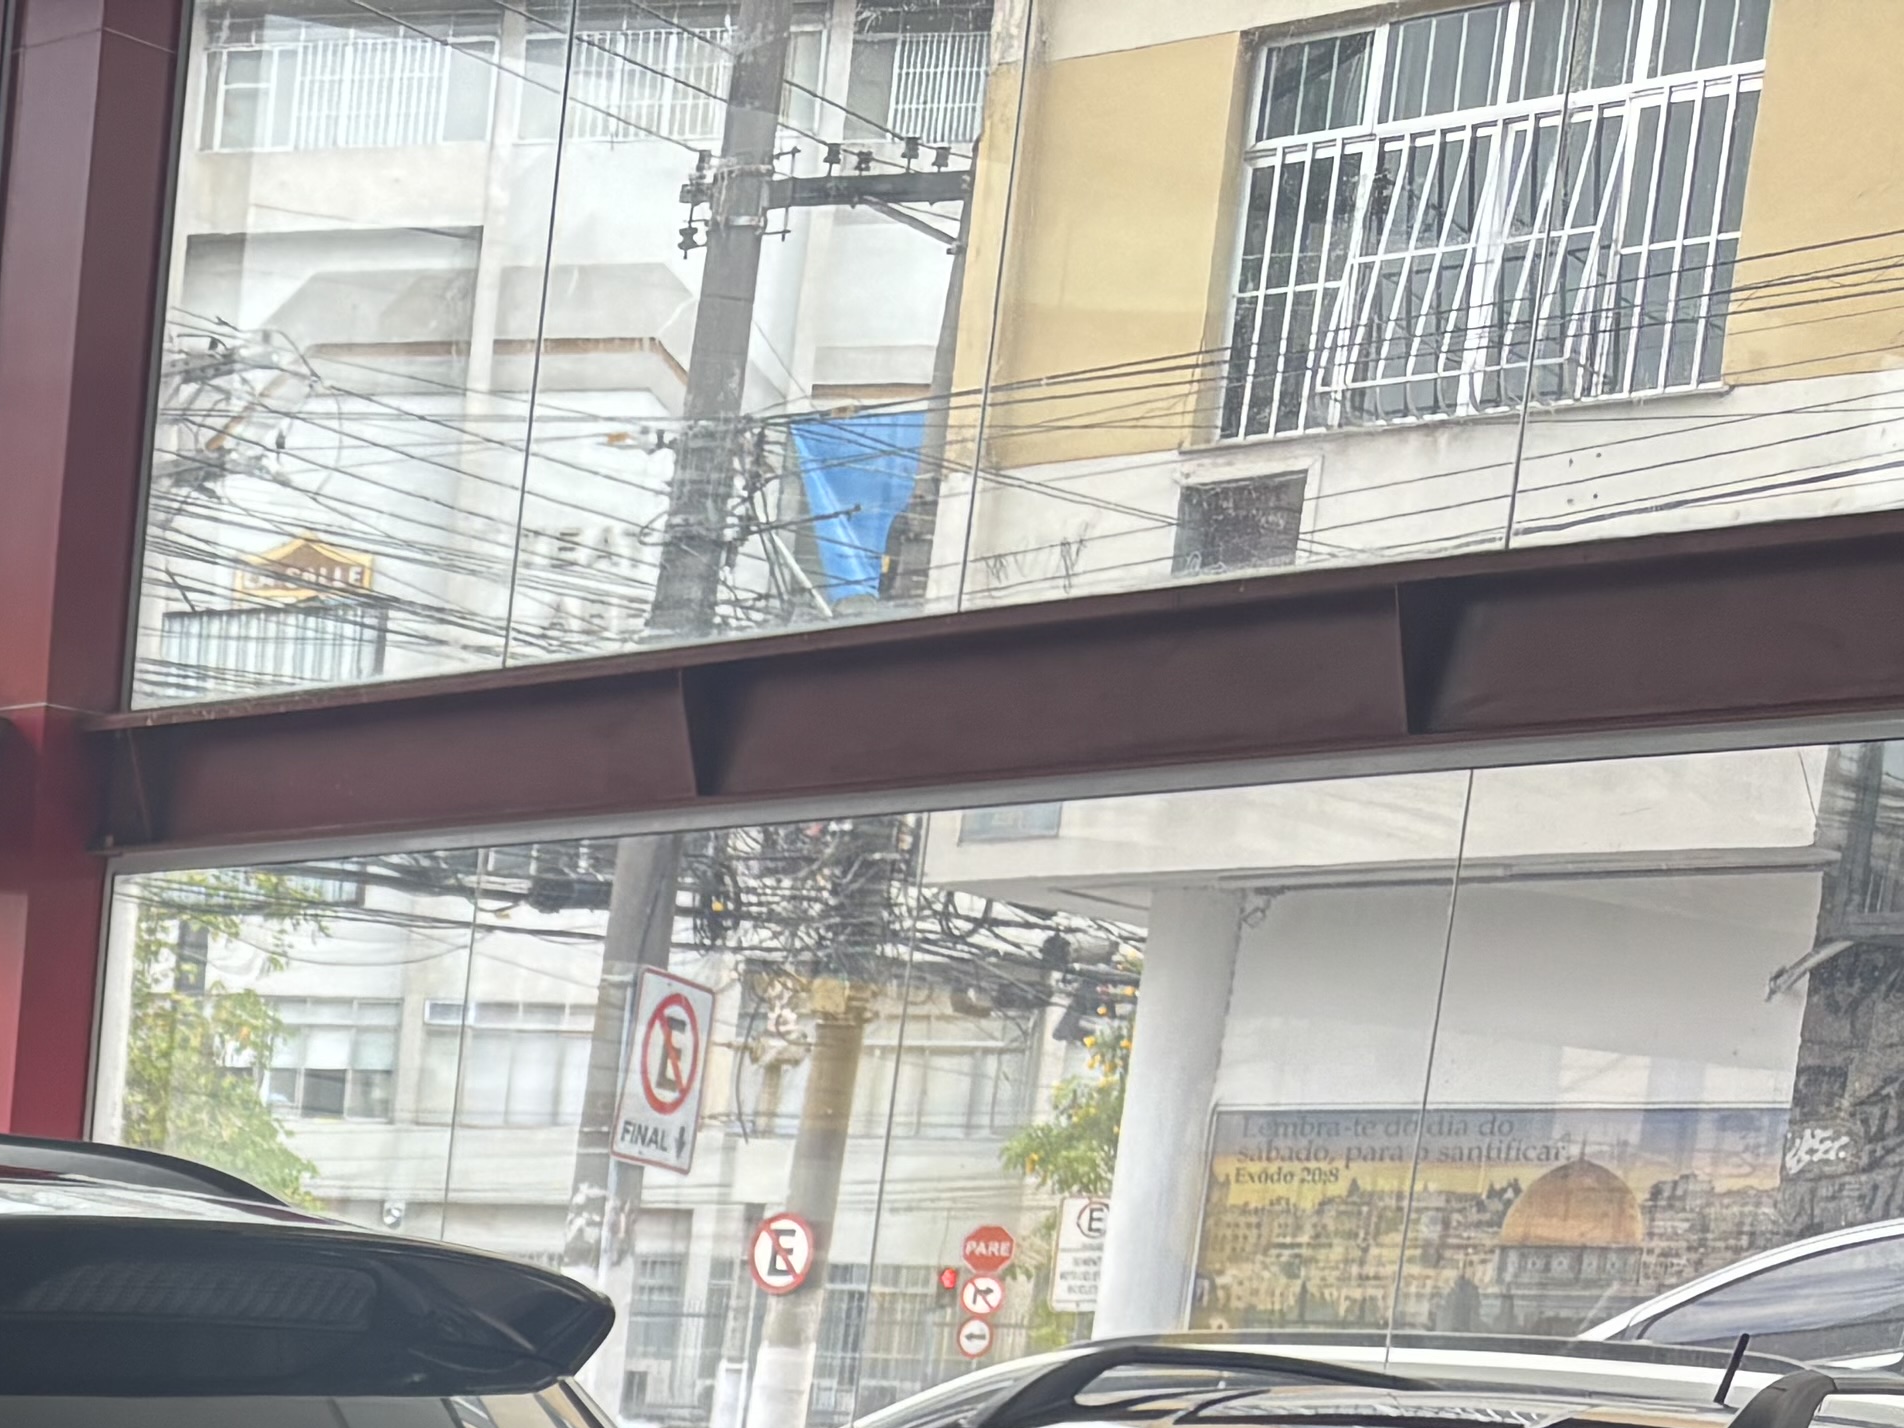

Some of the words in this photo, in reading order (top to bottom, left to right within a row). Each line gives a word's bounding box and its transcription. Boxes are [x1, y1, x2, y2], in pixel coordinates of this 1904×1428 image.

[620, 1119, 669, 1153] FINAL
[1426, 1114, 1469, 1137] dia
[1478, 1113, 1515, 1137] do
[1344, 1144, 1405, 1169] para
[965, 1240, 1011, 1257] PARE
